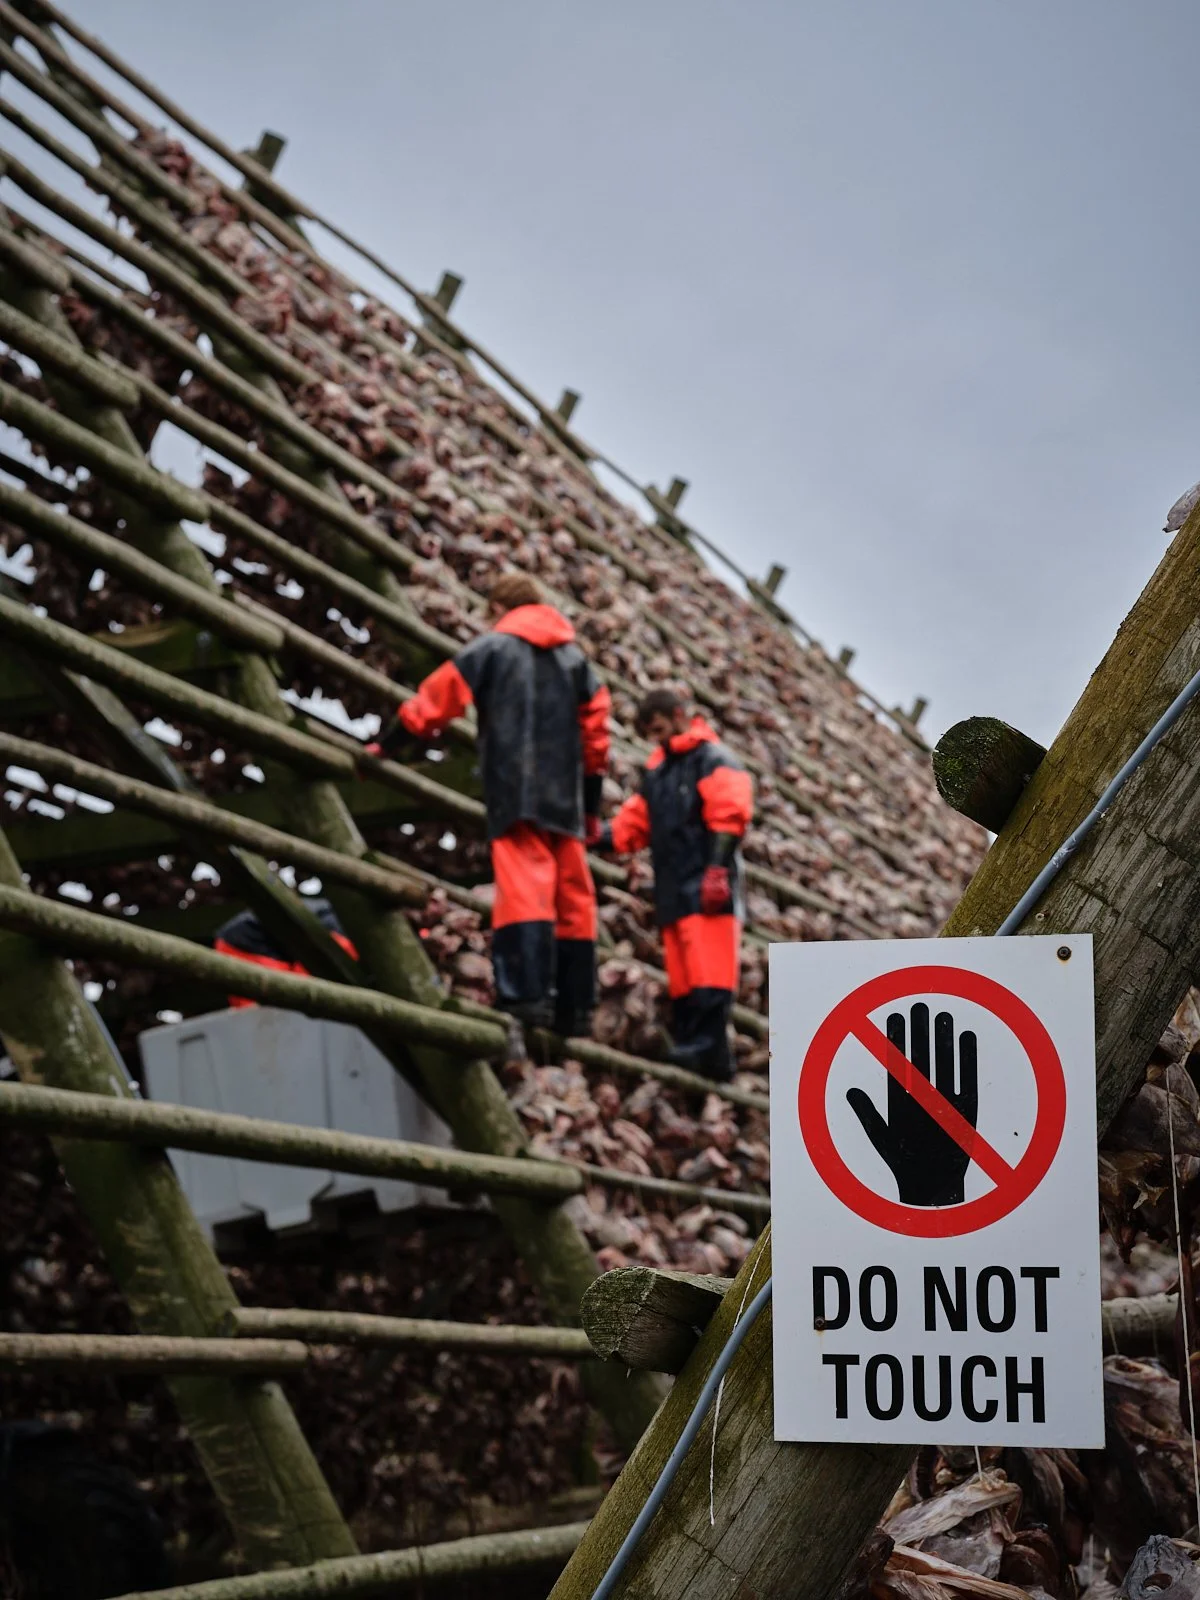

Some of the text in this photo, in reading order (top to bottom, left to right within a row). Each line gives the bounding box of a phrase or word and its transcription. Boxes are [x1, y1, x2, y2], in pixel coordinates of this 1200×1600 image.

[812, 1265, 1060, 1333] DO NOT
[821, 1353, 1046, 1424] TOUCH
